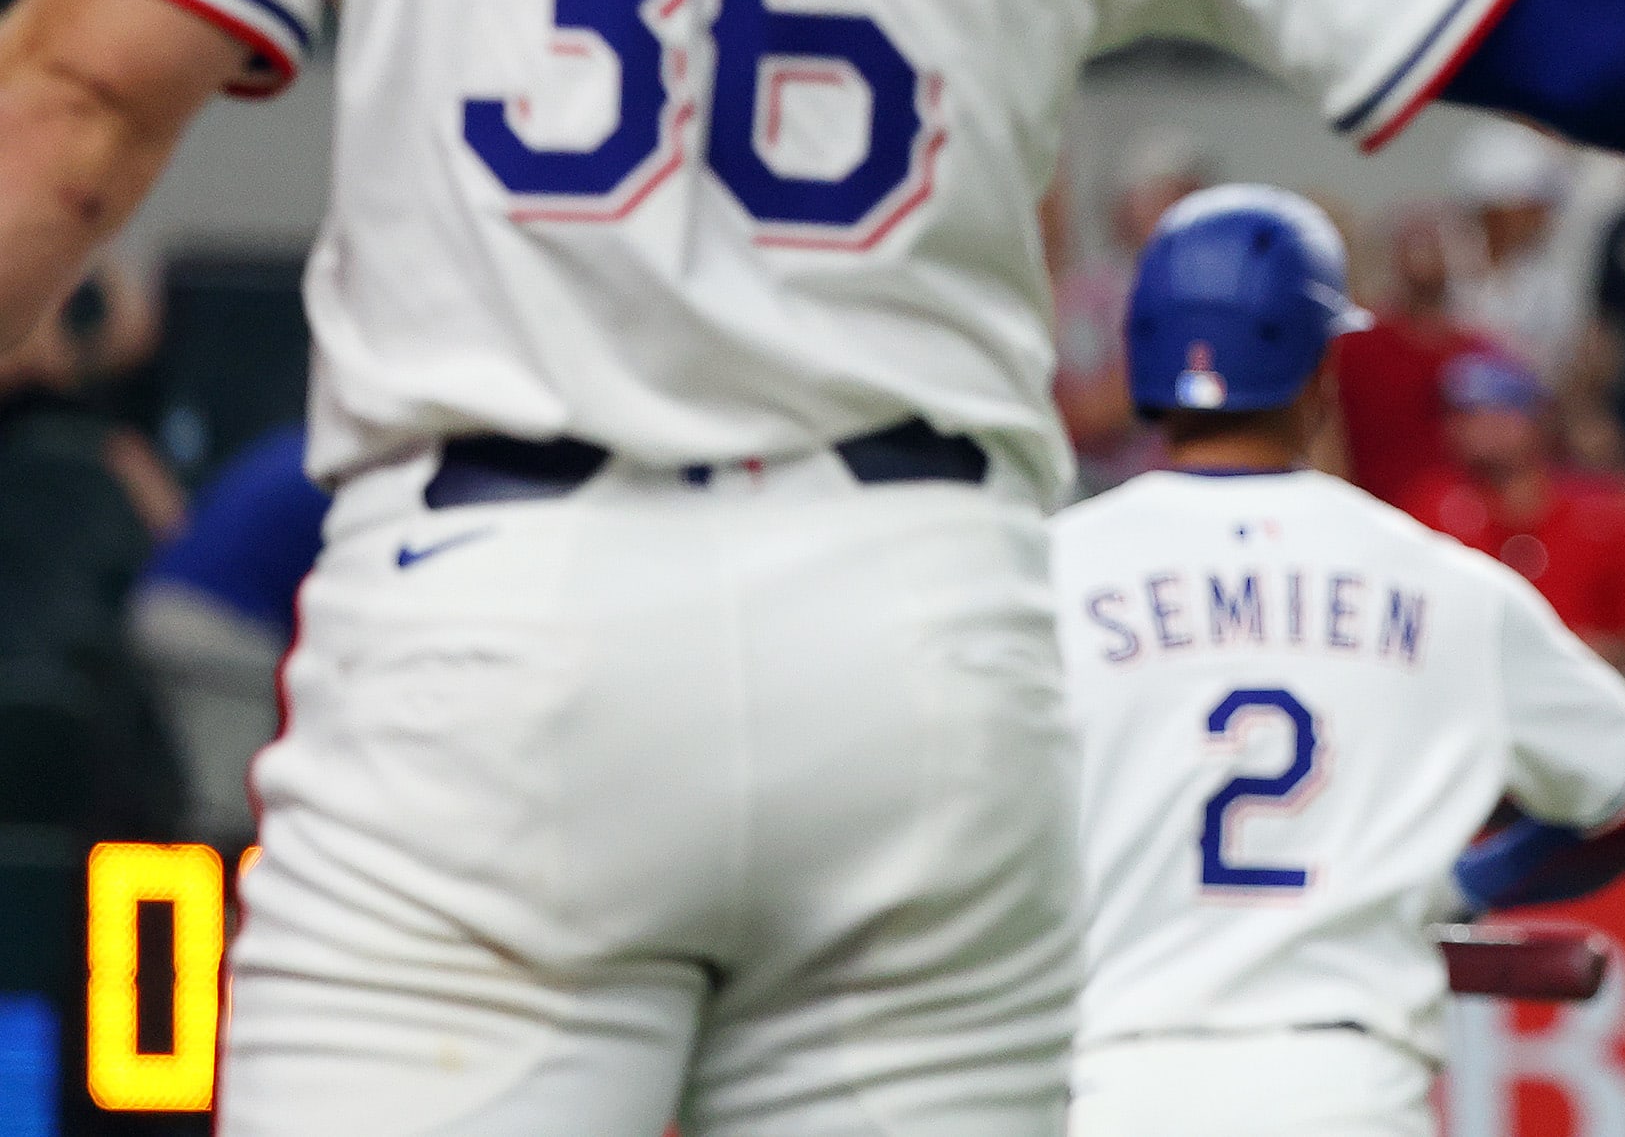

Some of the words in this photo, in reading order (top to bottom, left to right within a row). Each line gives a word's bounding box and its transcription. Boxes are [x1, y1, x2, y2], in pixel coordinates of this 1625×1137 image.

[1083, 570, 1428, 665] SEMIEN
[1199, 687, 1329, 904] 2
[86, 840, 263, 1111] 0
